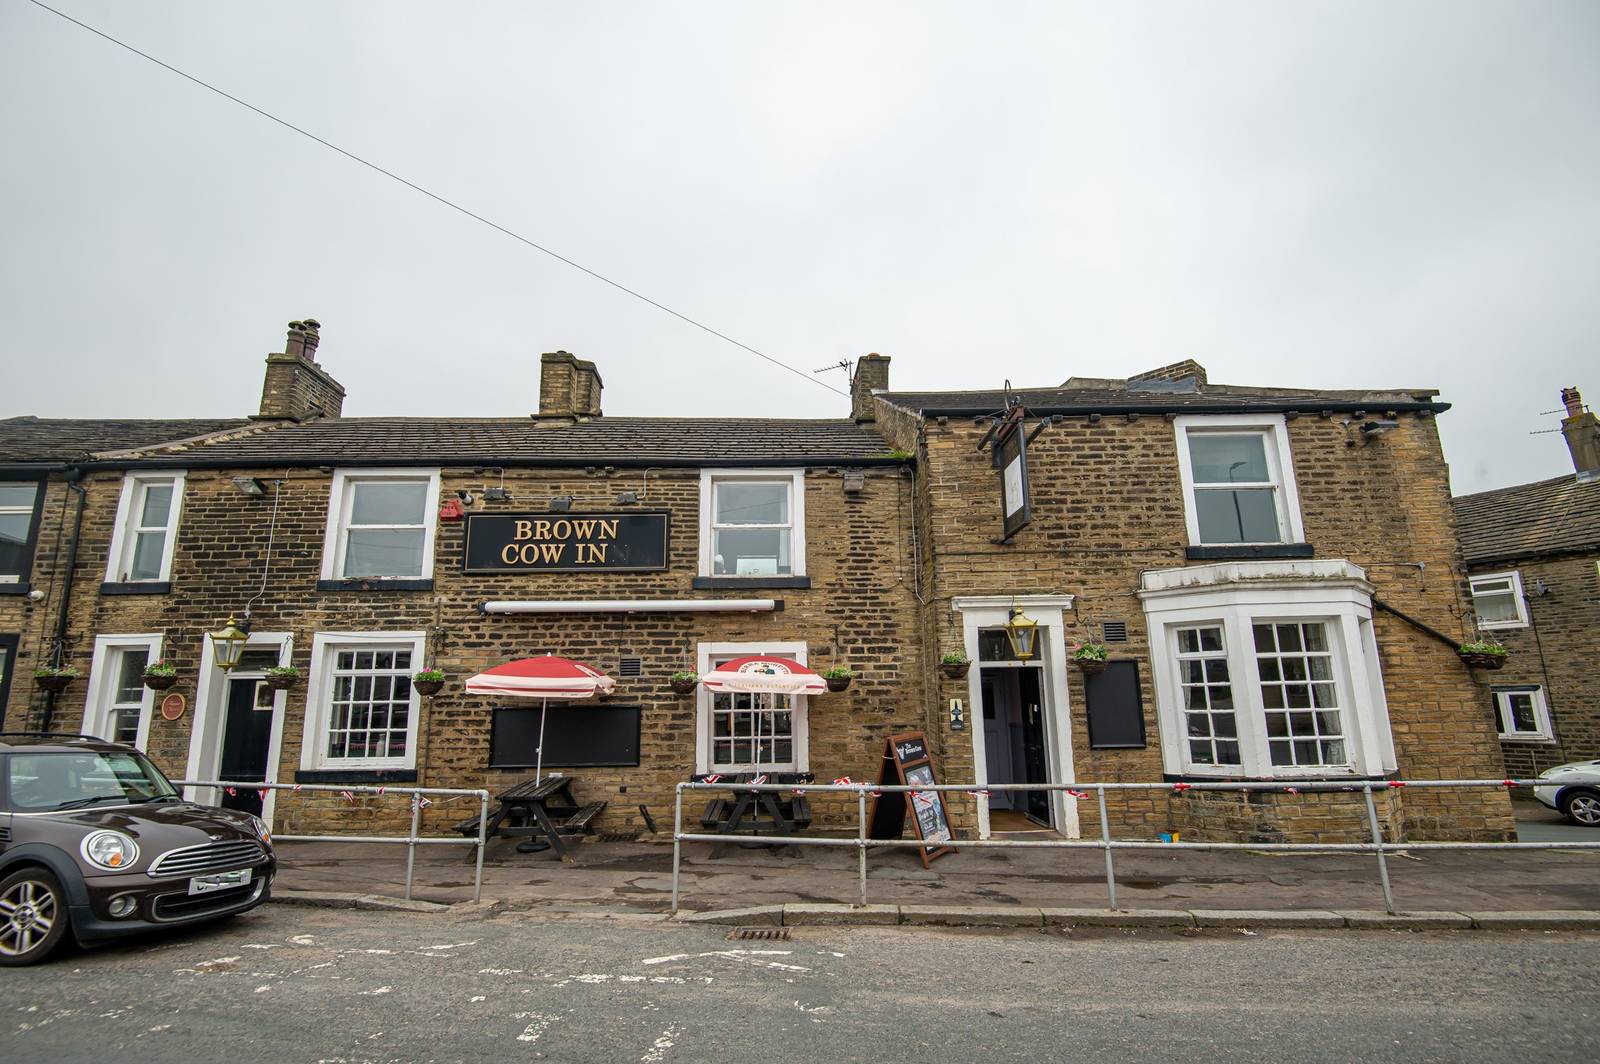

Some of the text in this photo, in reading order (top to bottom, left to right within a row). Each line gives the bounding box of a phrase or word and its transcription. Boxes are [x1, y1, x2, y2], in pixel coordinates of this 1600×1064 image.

[513, 520, 619, 540] BROWN
[501, 543, 608, 564] COW IN
